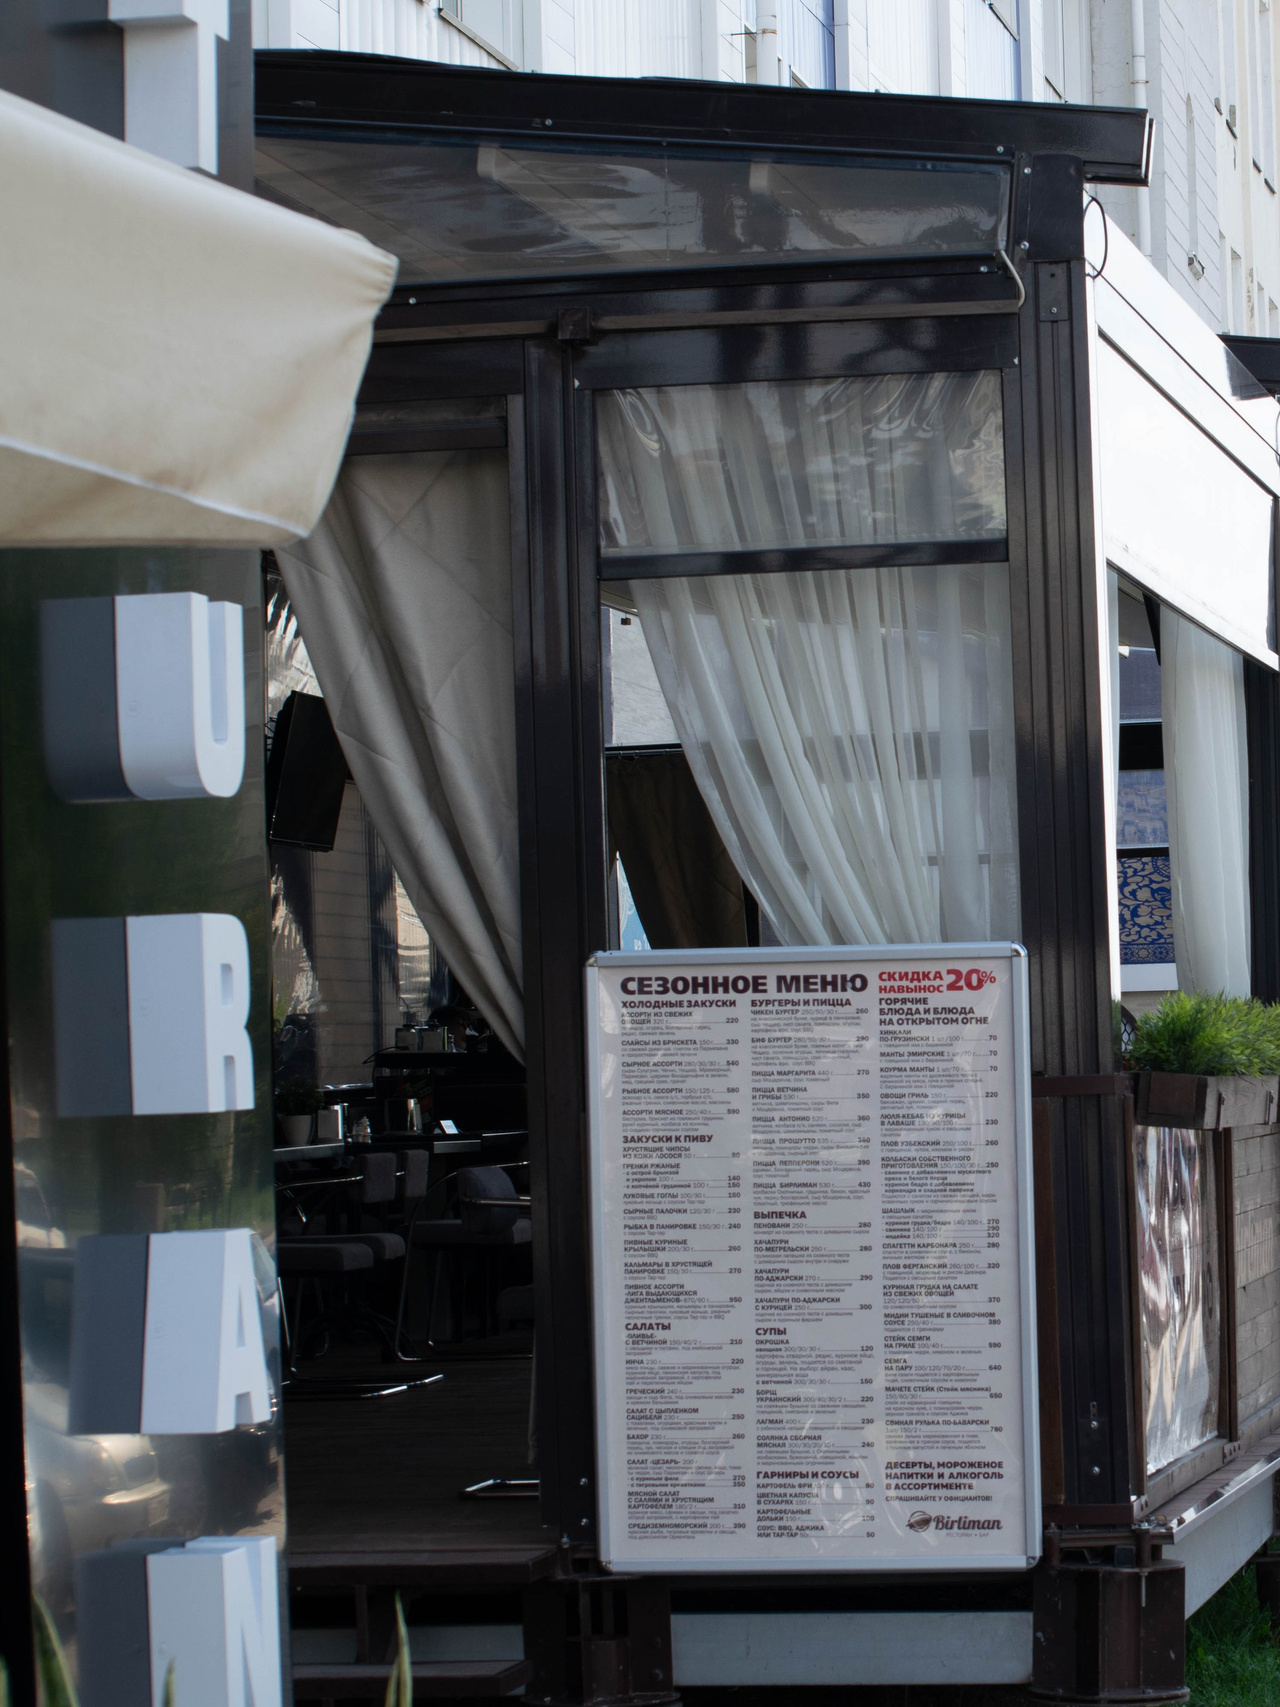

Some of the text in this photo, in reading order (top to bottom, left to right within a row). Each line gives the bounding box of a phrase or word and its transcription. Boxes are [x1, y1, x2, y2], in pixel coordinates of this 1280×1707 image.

[878, 968, 996, 991] СКИДКА 20%
[621, 974, 868, 995] СЕЗОННОЕ МЕНЮ
[879, 985, 944, 993] НАВЫНОС
[622, 1000, 684, 1009] ХОЛОДНЫЕ
[813, 999, 851, 1007] ПИЦЦА
[933, 1007, 974, 1015] БЛЮДА
[754, 1211, 807, 1219] ВЫПЕЧКА
[885, 1461, 934, 1470] ДЕСЕРТЫ,
[933, 1515, 1002, 1530] Birliman
